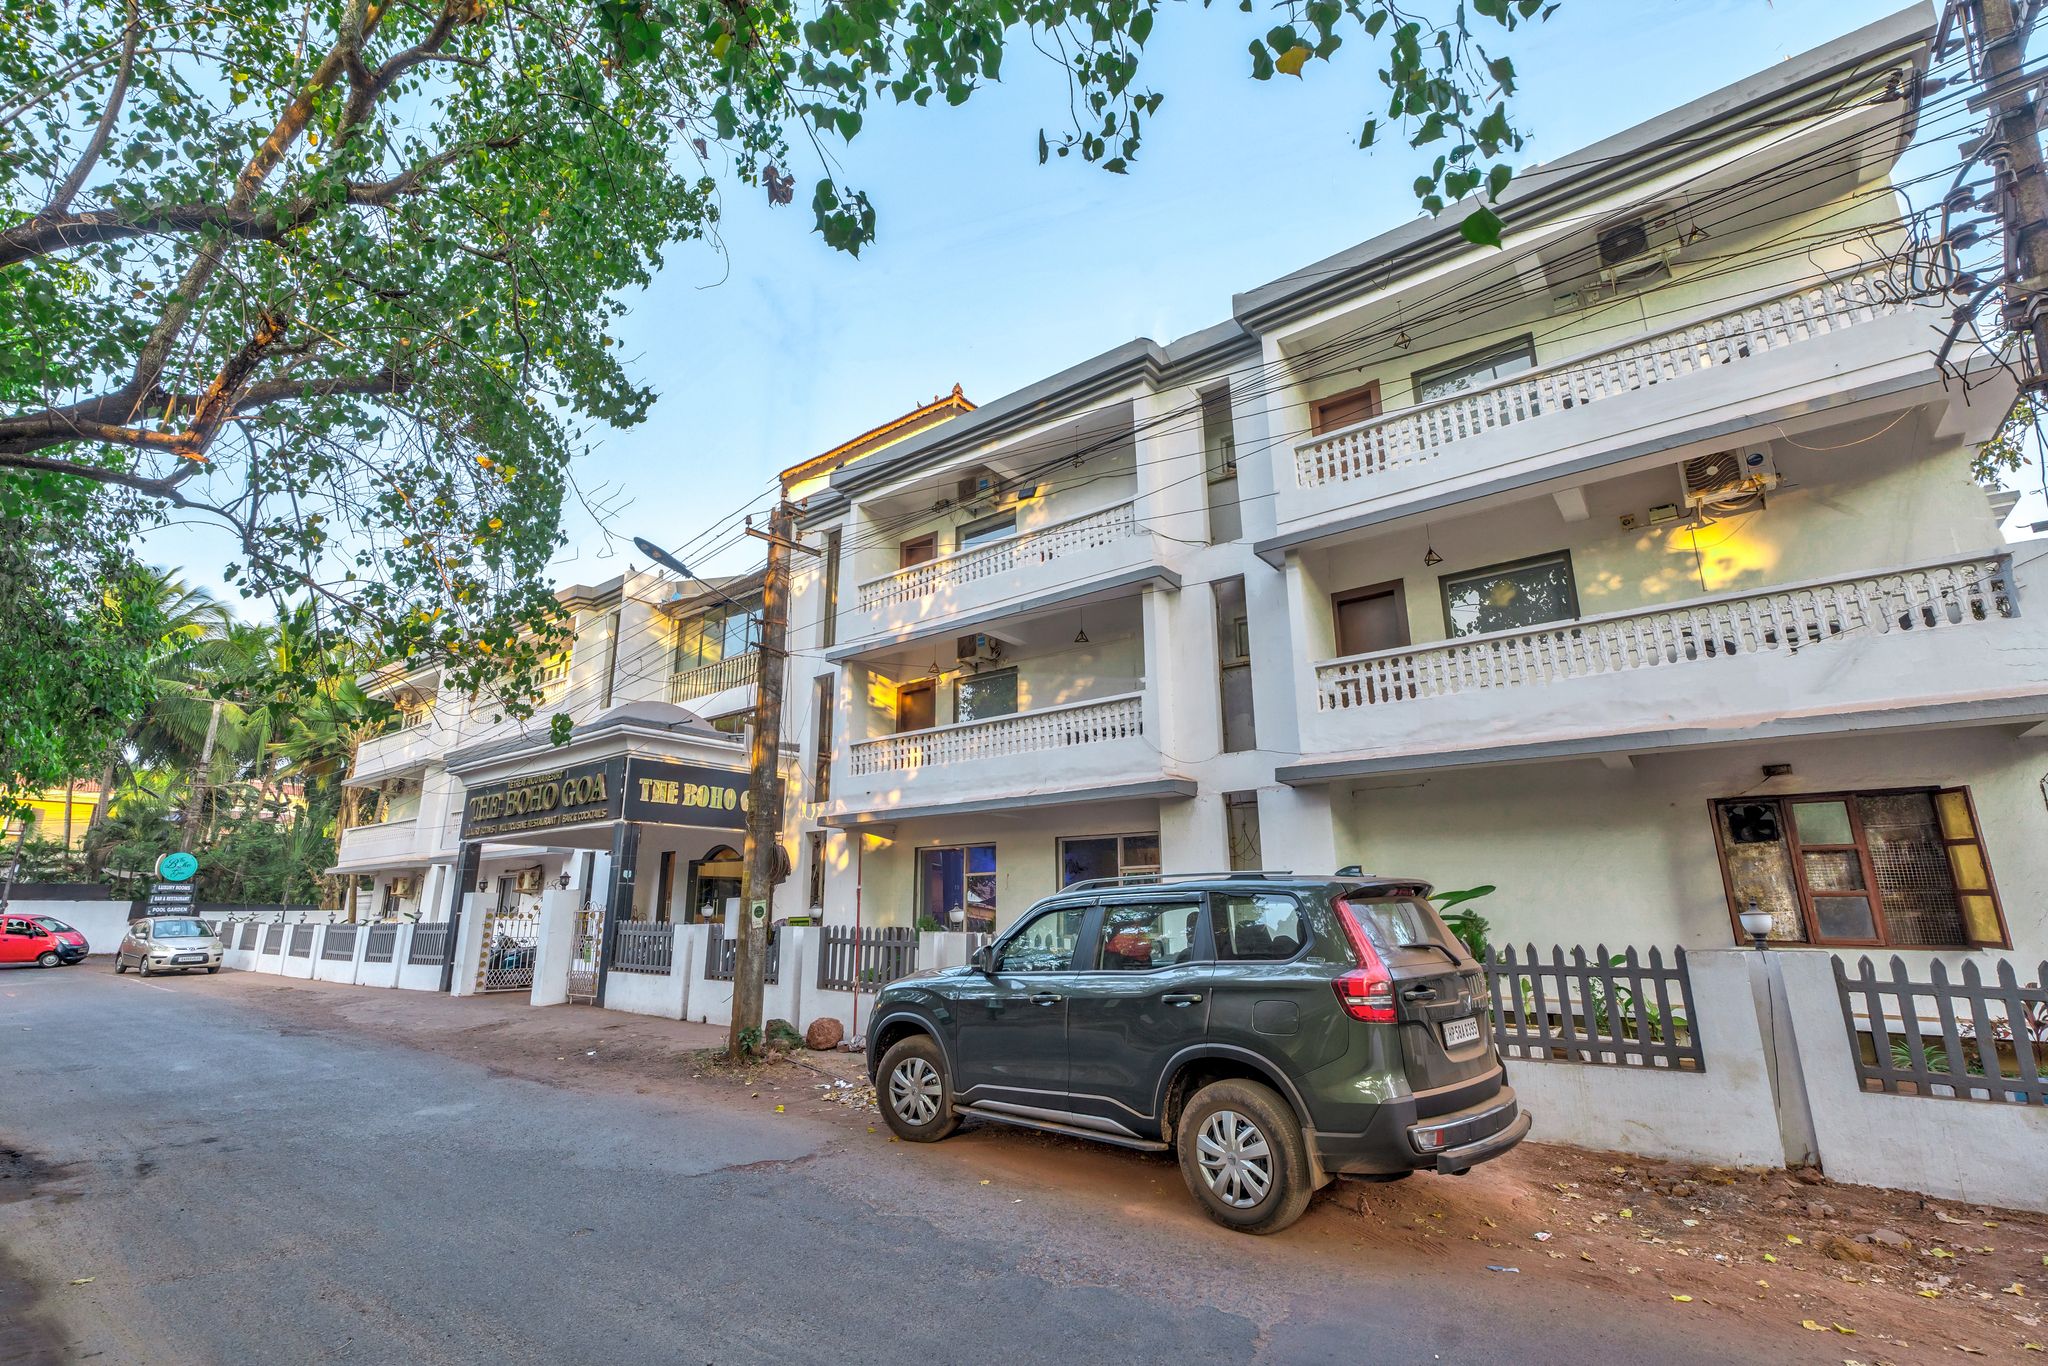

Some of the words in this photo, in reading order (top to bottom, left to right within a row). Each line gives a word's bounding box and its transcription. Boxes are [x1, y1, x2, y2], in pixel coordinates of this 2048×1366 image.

[470, 792, 504, 821] THE
[504, 783, 559, 816] BOHO
[562, 772, 608, 807] GOA
[639, 778, 679, 804] THE
[682, 783, 737, 811] BOHO
